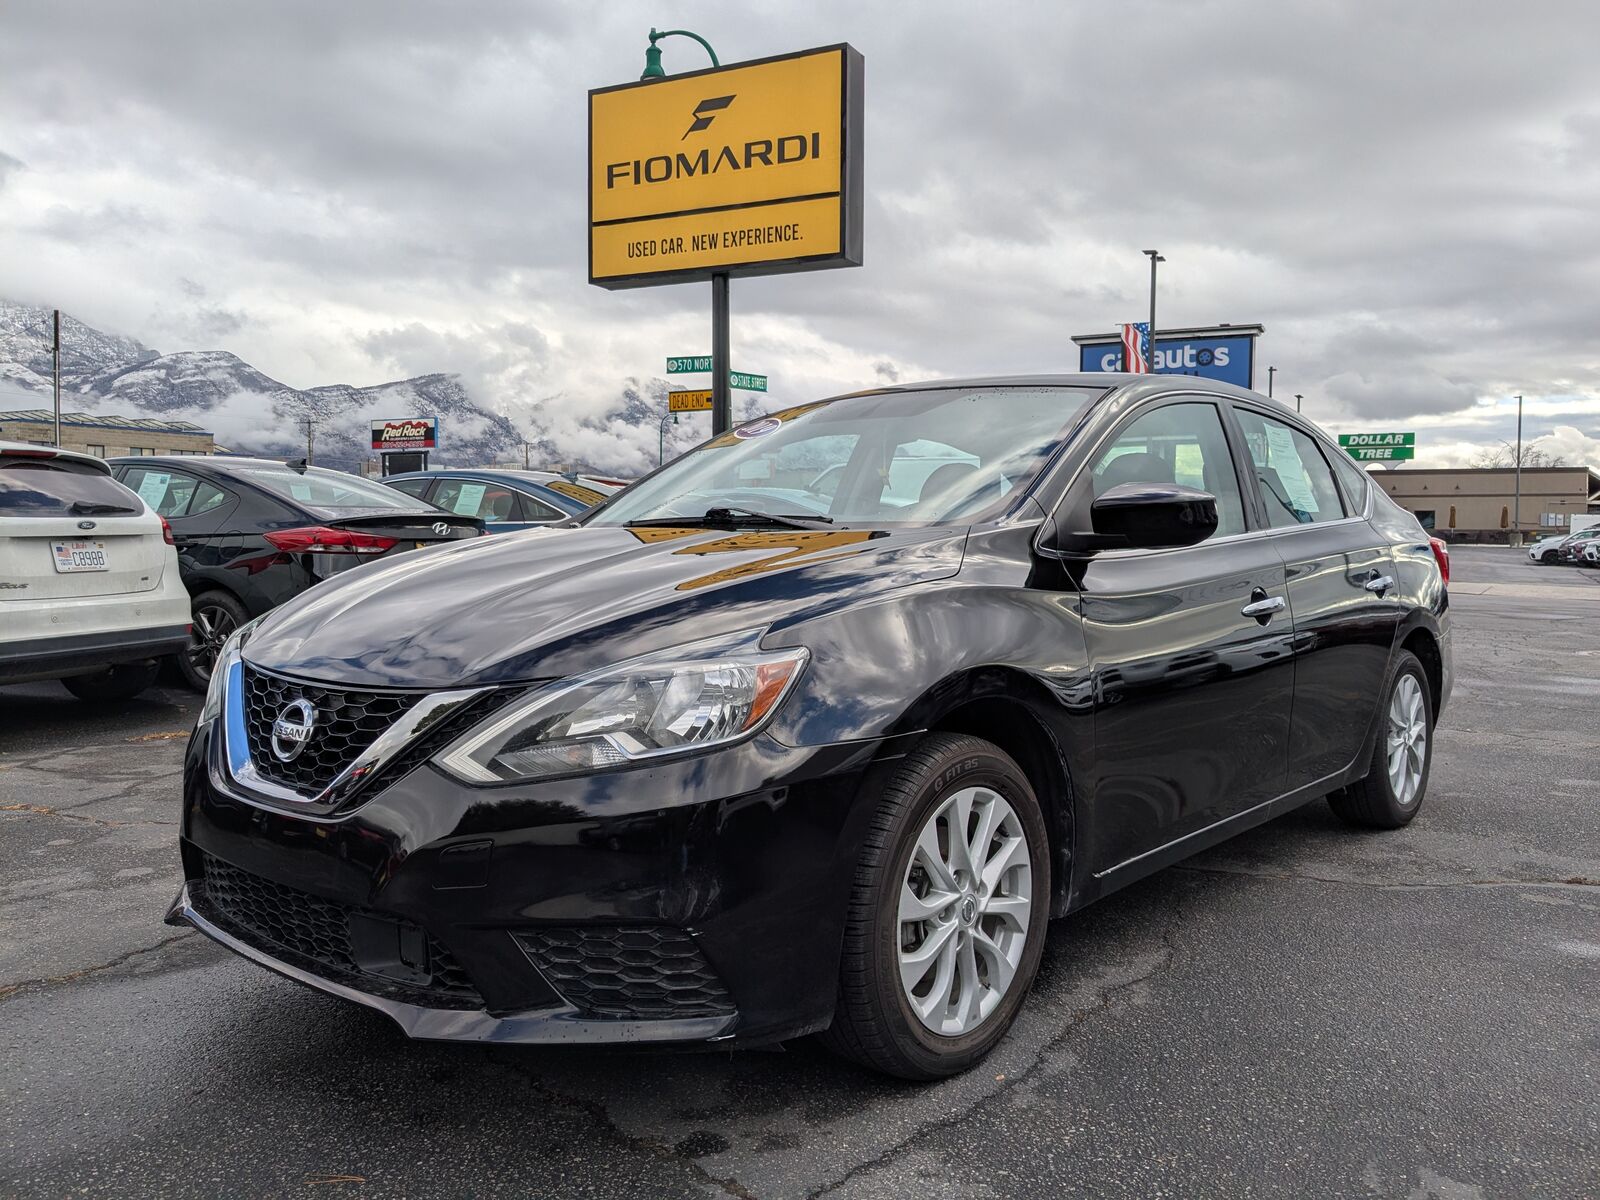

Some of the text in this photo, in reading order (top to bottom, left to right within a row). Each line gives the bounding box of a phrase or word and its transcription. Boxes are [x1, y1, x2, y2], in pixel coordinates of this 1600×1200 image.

[606, 131, 820, 189] FIOMARDI
[627, 223, 804, 258] USED CAR. NEW EXPERIENCE.
[678, 360, 692, 370] 570
[738, 375, 767, 389] STATE STREET
[672, 394, 704, 409] DEAD END
[382, 424, 426, 441] Red Rock
[1348, 434, 1404, 445] DOLLAR
[1358, 448, 1393, 458] TREE
[945, 763, 963, 781] FIT
